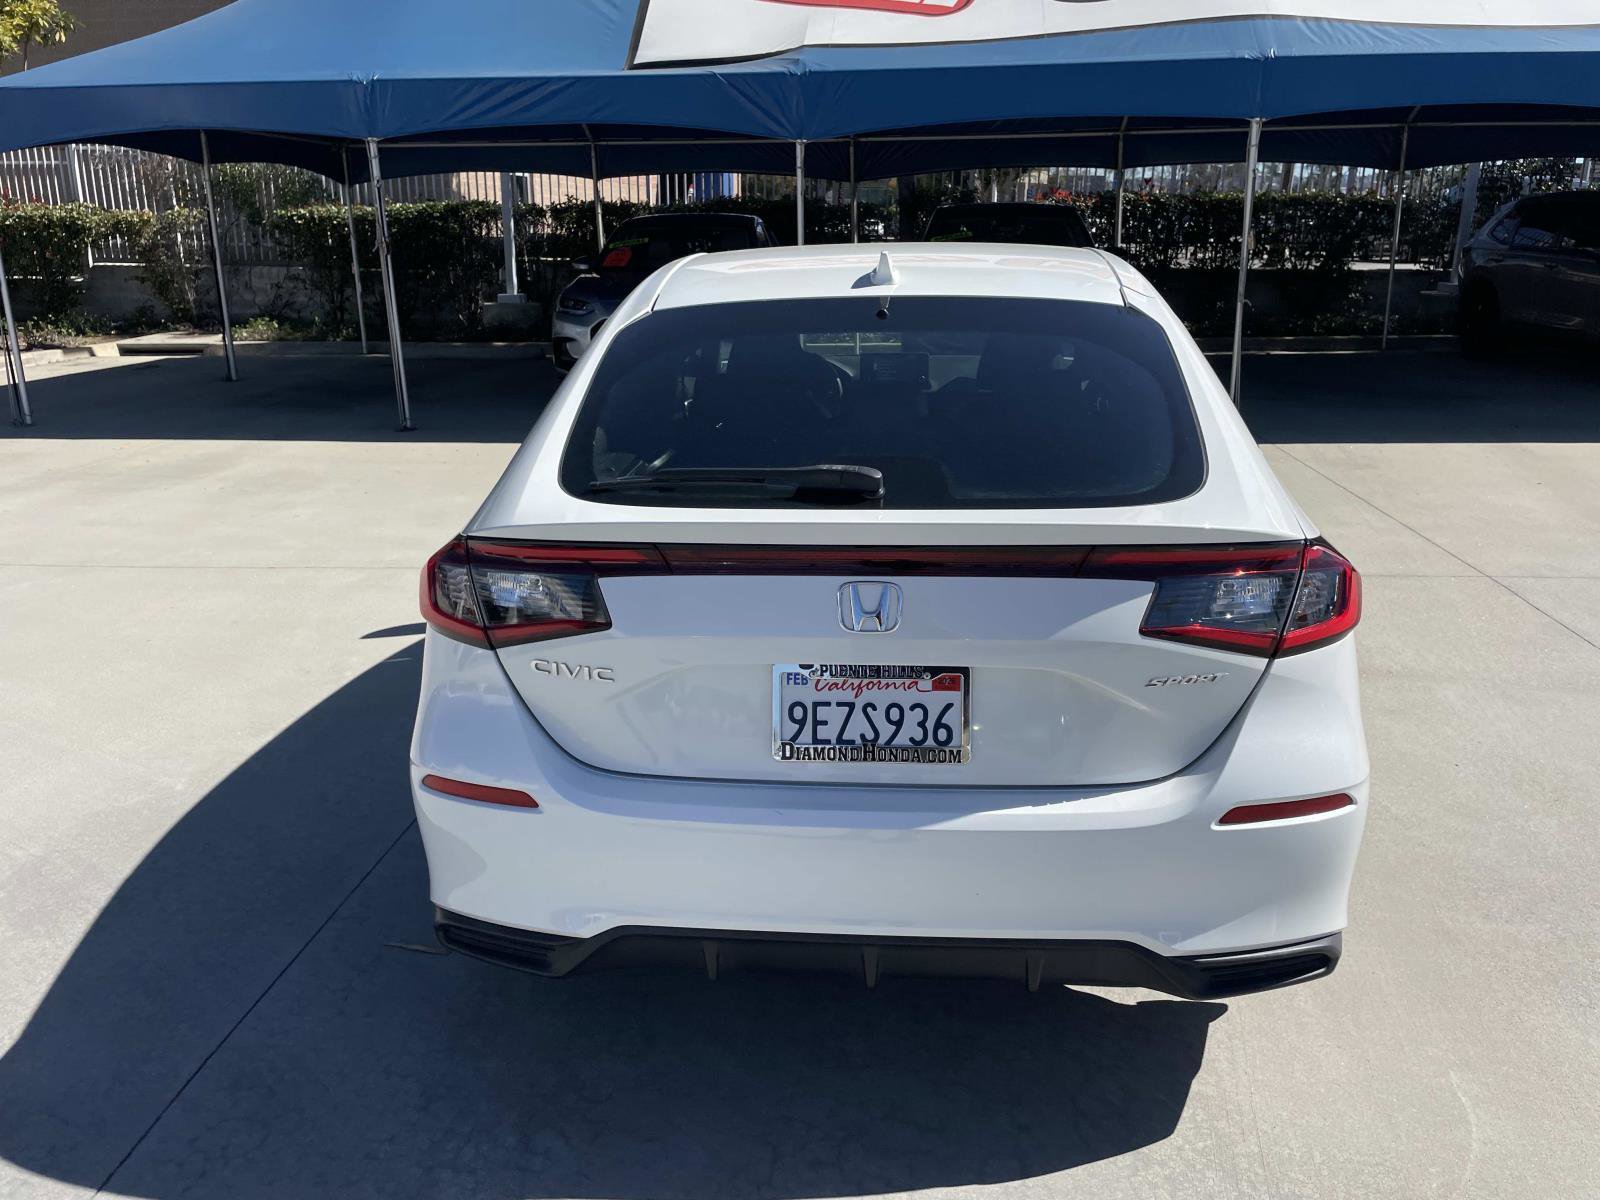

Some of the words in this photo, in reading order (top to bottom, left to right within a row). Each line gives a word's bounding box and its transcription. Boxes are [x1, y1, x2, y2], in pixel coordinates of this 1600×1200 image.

[530, 659, 615, 682] CIVIC
[786, 672, 809, 686] FEB
[820, 664, 877, 679] PUENTE
[880, 665, 924, 679] HILLS
[814, 678, 932, 699] California
[787, 700, 955, 747] 9EZS936
